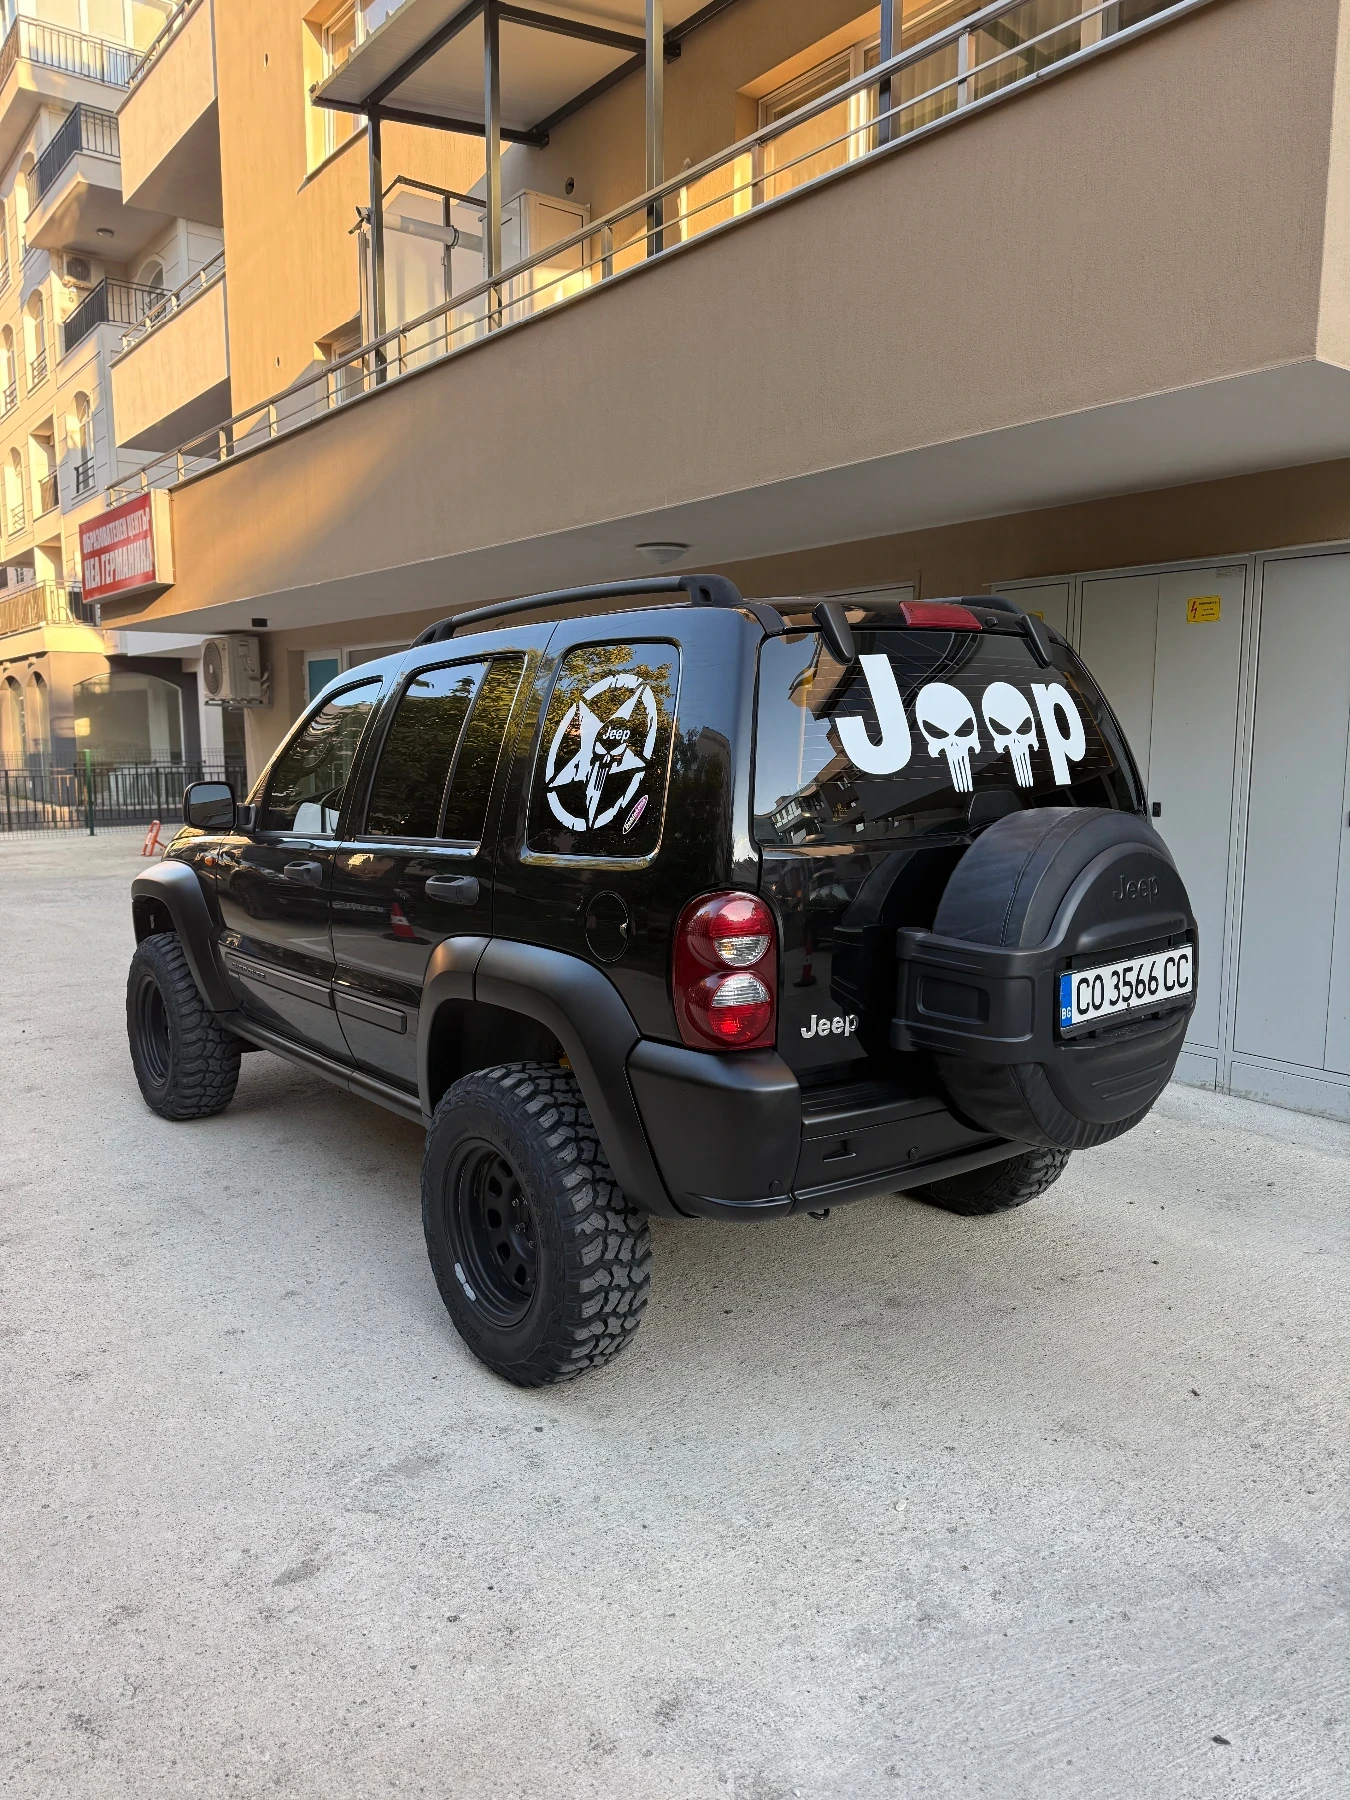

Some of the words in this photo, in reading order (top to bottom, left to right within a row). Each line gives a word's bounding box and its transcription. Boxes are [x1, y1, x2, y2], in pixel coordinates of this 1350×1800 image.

[127, 507, 150, 539] ЦЕНТЪР
[84, 556, 101, 590] НЕА
[101, 537, 153, 585] ГЕРМАНИКА
[602, 726, 631, 743] Jeep
[1112, 875, 1160, 903] Jeep
[1076, 974, 1104, 1015] CO
[1109, 960, 1159, 1006] 3566
[1163, 953, 1189, 992] CC
[800, 1014, 859, 1039] Jeep
[1061, 1007, 1072, 1020] BG
